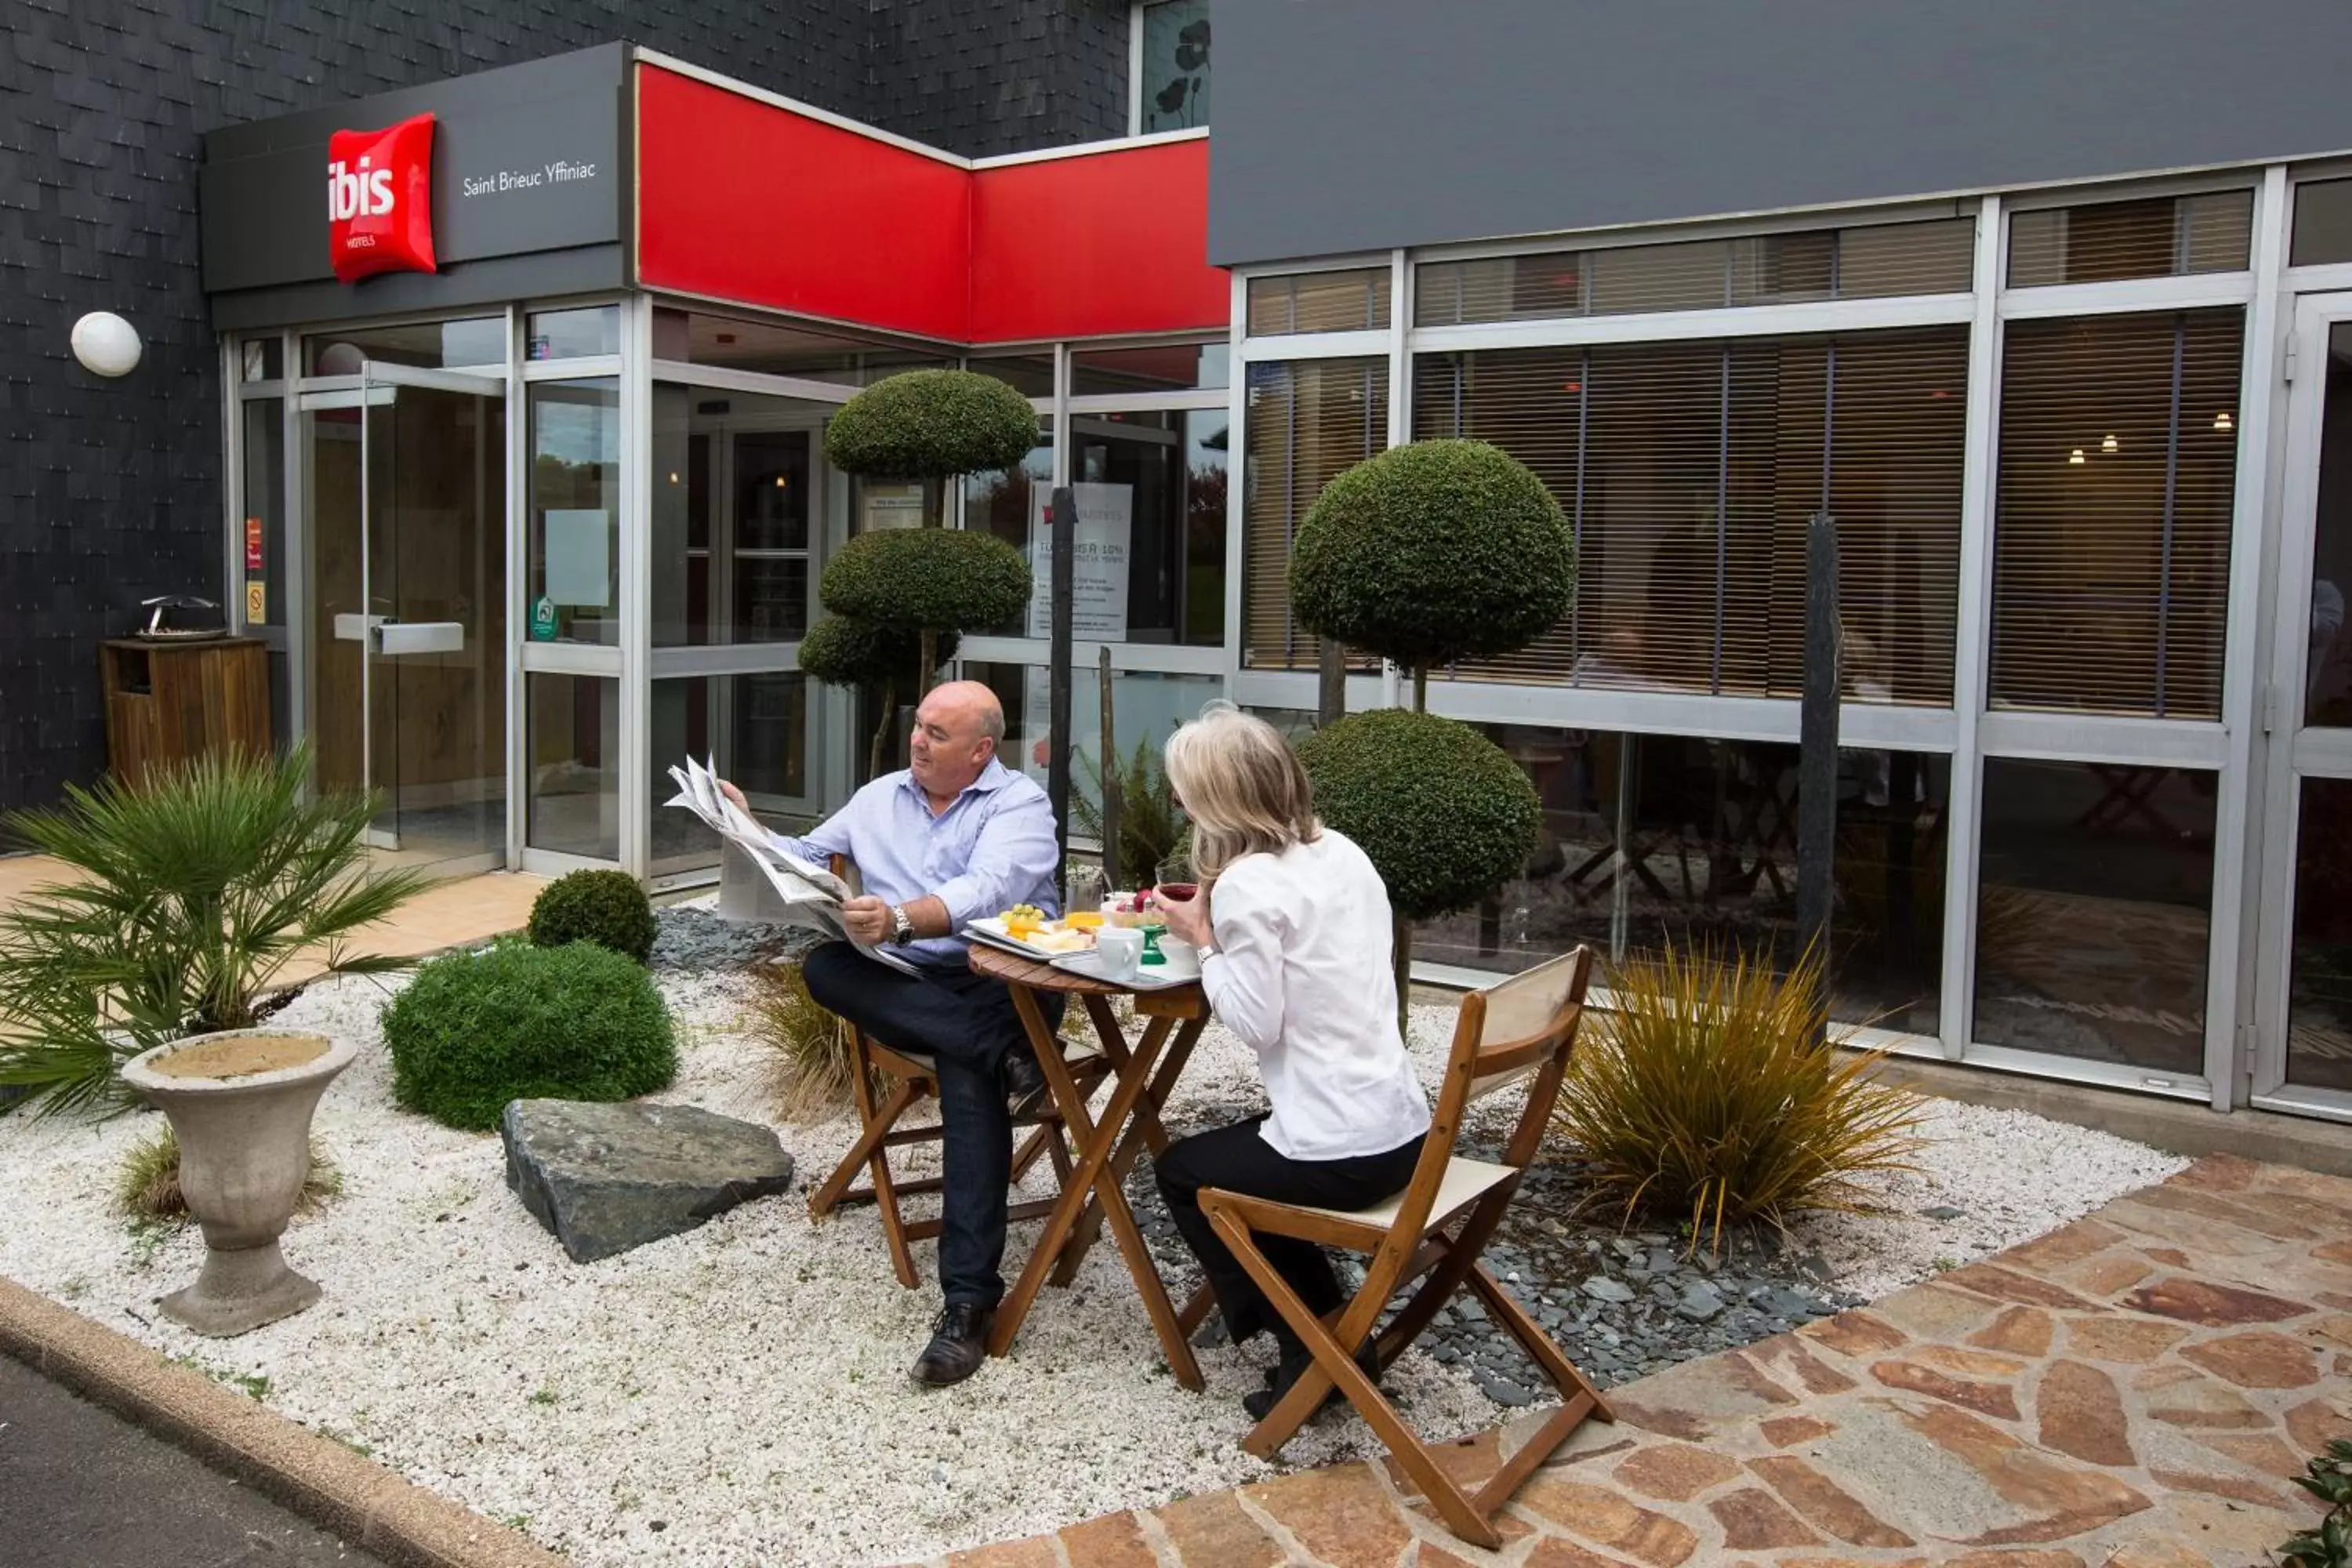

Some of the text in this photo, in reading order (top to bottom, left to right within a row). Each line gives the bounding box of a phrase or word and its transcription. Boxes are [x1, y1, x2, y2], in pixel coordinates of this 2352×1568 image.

[328, 156, 395, 222] ibis
[463, 159, 596, 197] Saint Brieuc Yffiniac
[346, 235, 376, 249] HOTELS
